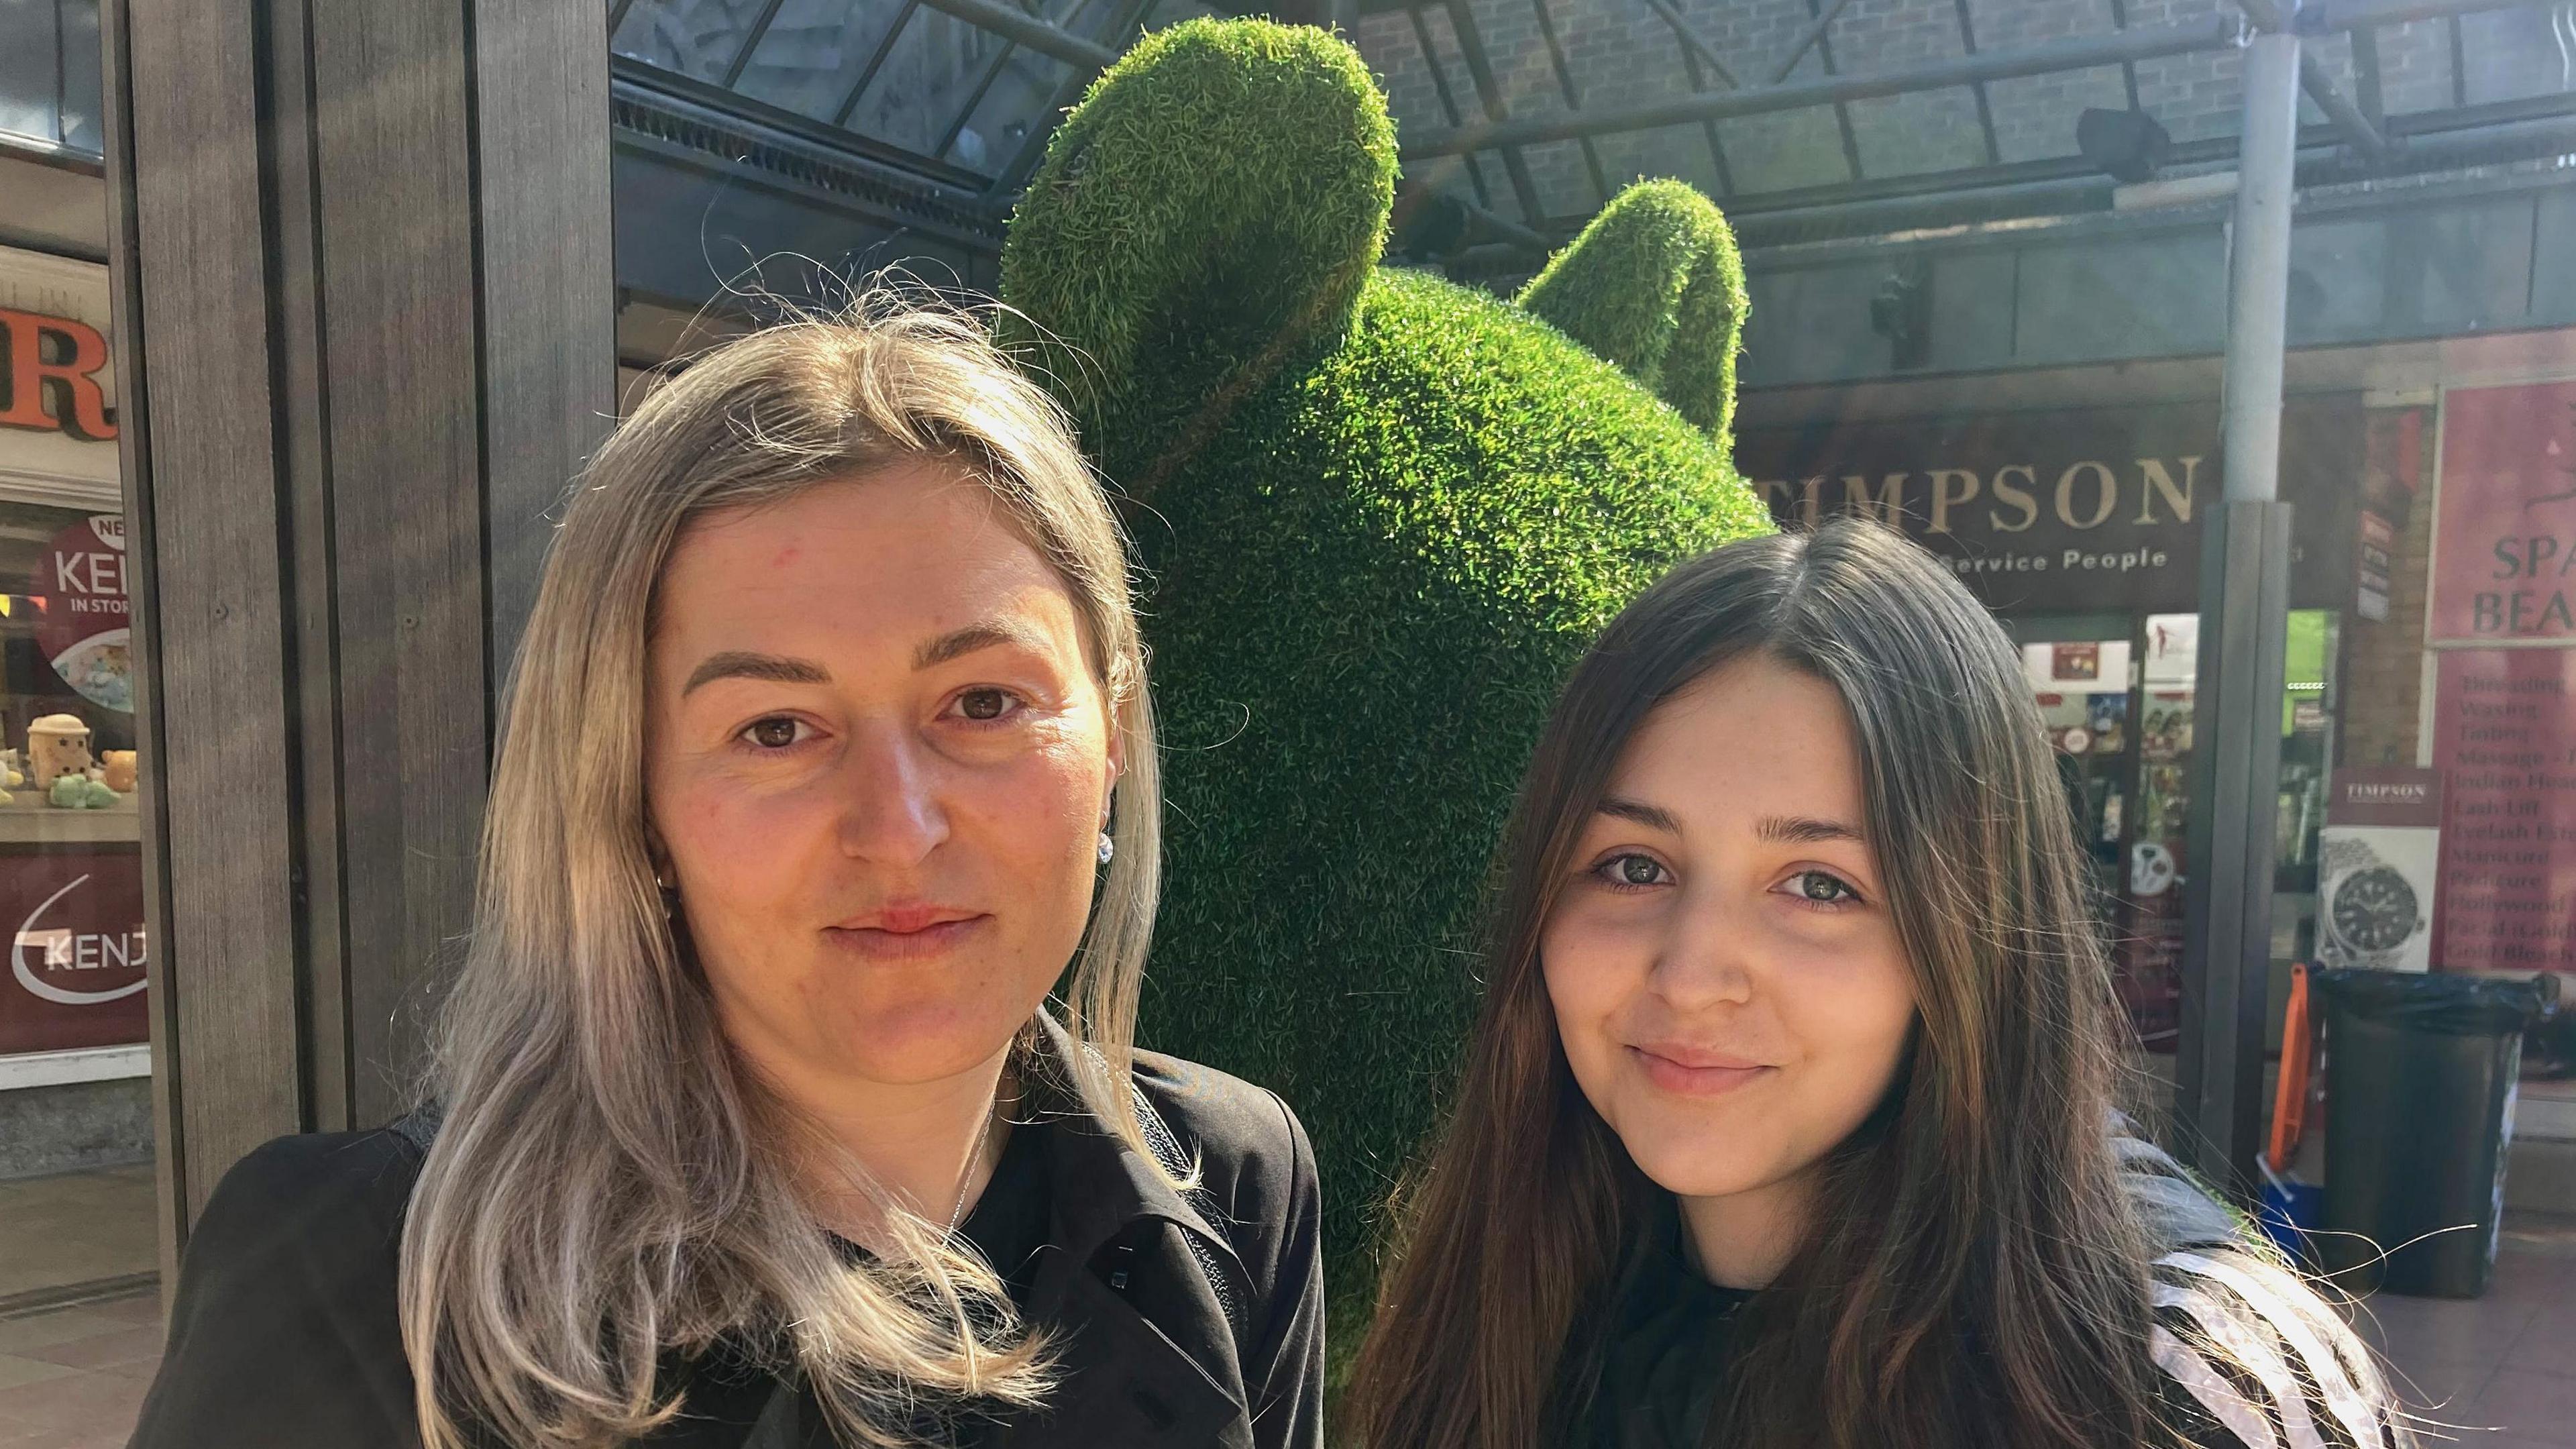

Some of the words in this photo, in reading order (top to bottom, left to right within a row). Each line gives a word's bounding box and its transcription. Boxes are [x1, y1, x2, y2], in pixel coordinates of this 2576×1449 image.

[0, 307, 119, 440] R
[2063, 546, 2167, 572] People
[70, 598, 88, 612] IN
[2347, 783, 2426, 797] TIMPSON
